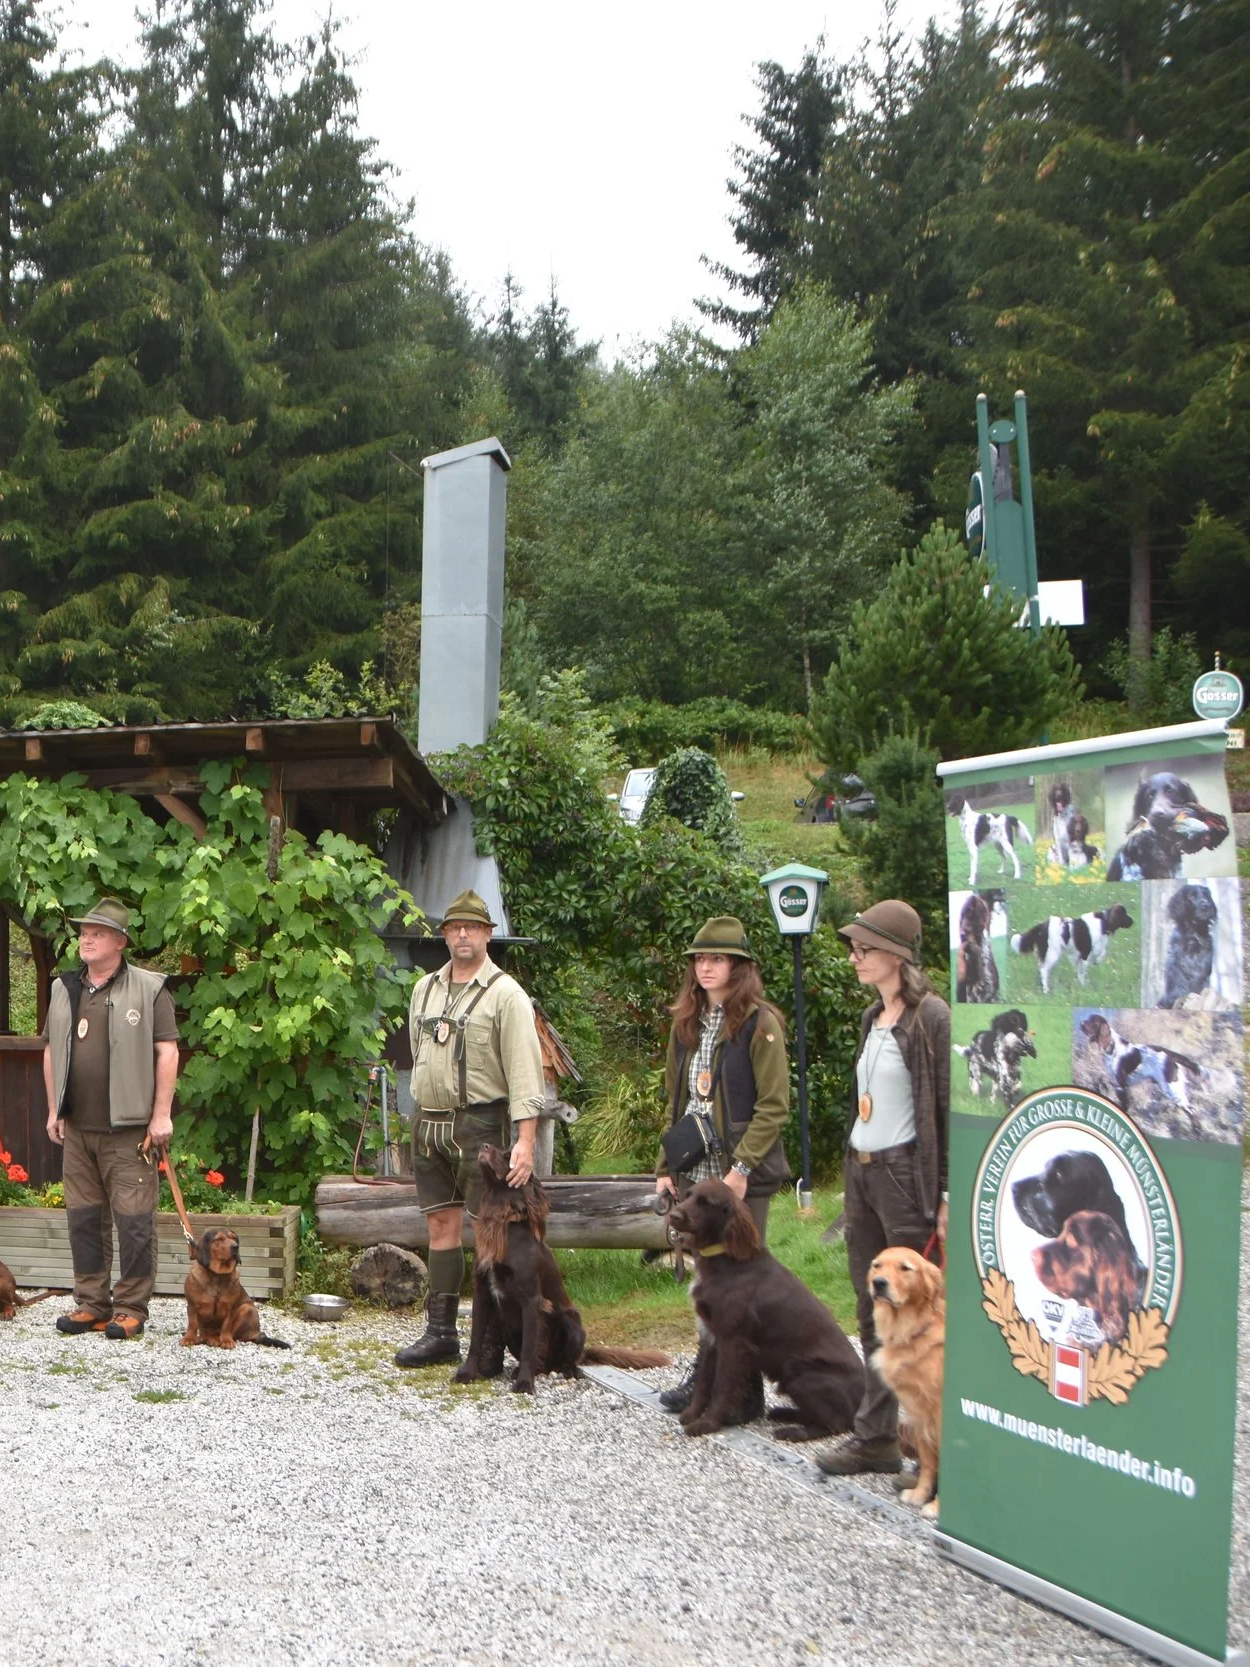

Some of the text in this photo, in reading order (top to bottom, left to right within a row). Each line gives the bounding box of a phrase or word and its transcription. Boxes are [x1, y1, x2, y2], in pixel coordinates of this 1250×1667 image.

[979, 1098, 1174, 1308] ÖSTERR. VEREIN FÜR GROSSE & KLEINE MÜNSTERLÄNDER
[960, 1397, 1197, 1499] www.muensterlaender.info
